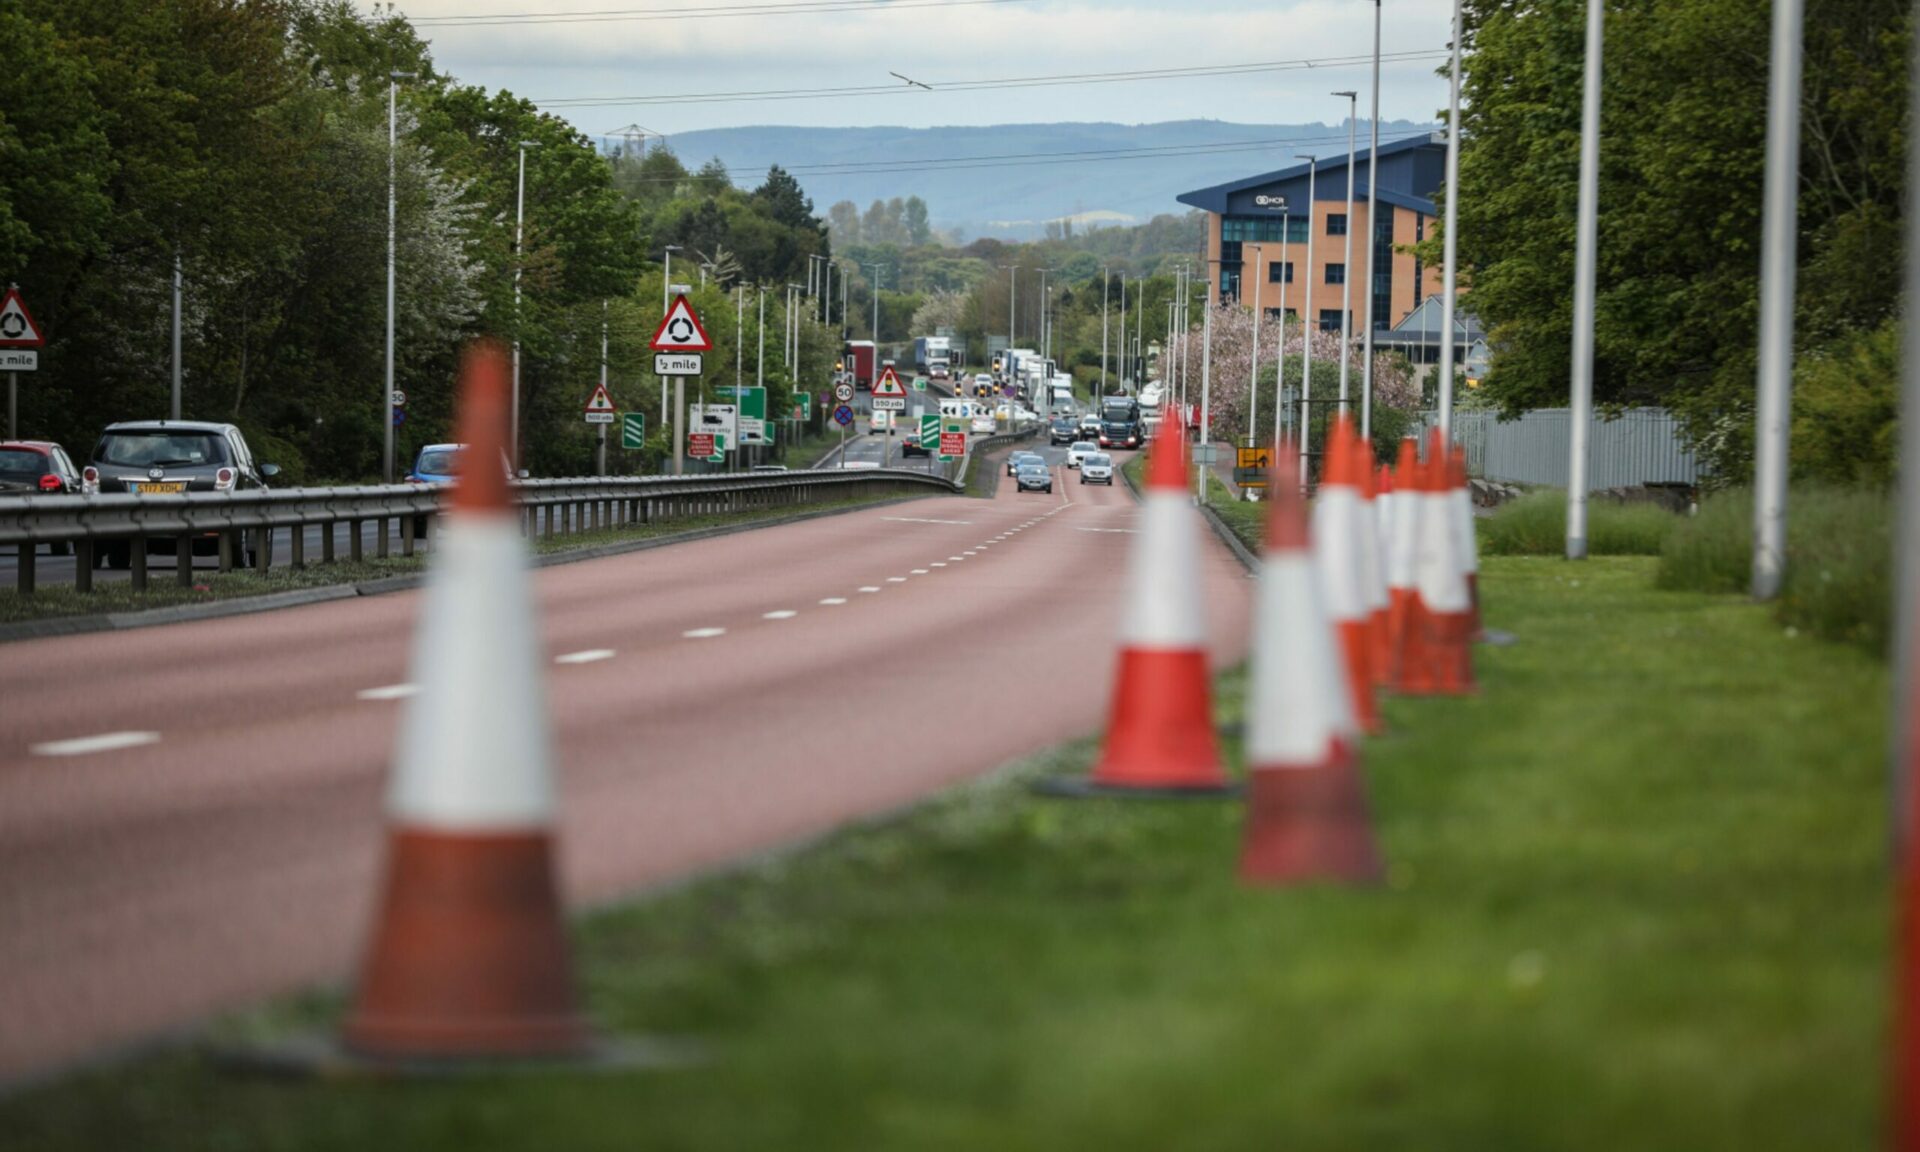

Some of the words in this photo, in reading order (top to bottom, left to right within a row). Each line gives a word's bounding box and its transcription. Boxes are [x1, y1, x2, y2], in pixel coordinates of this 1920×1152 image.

[8, 355, 33, 365] mile
[672, 359, 697, 369] mile
[838, 388, 851, 397] 50
